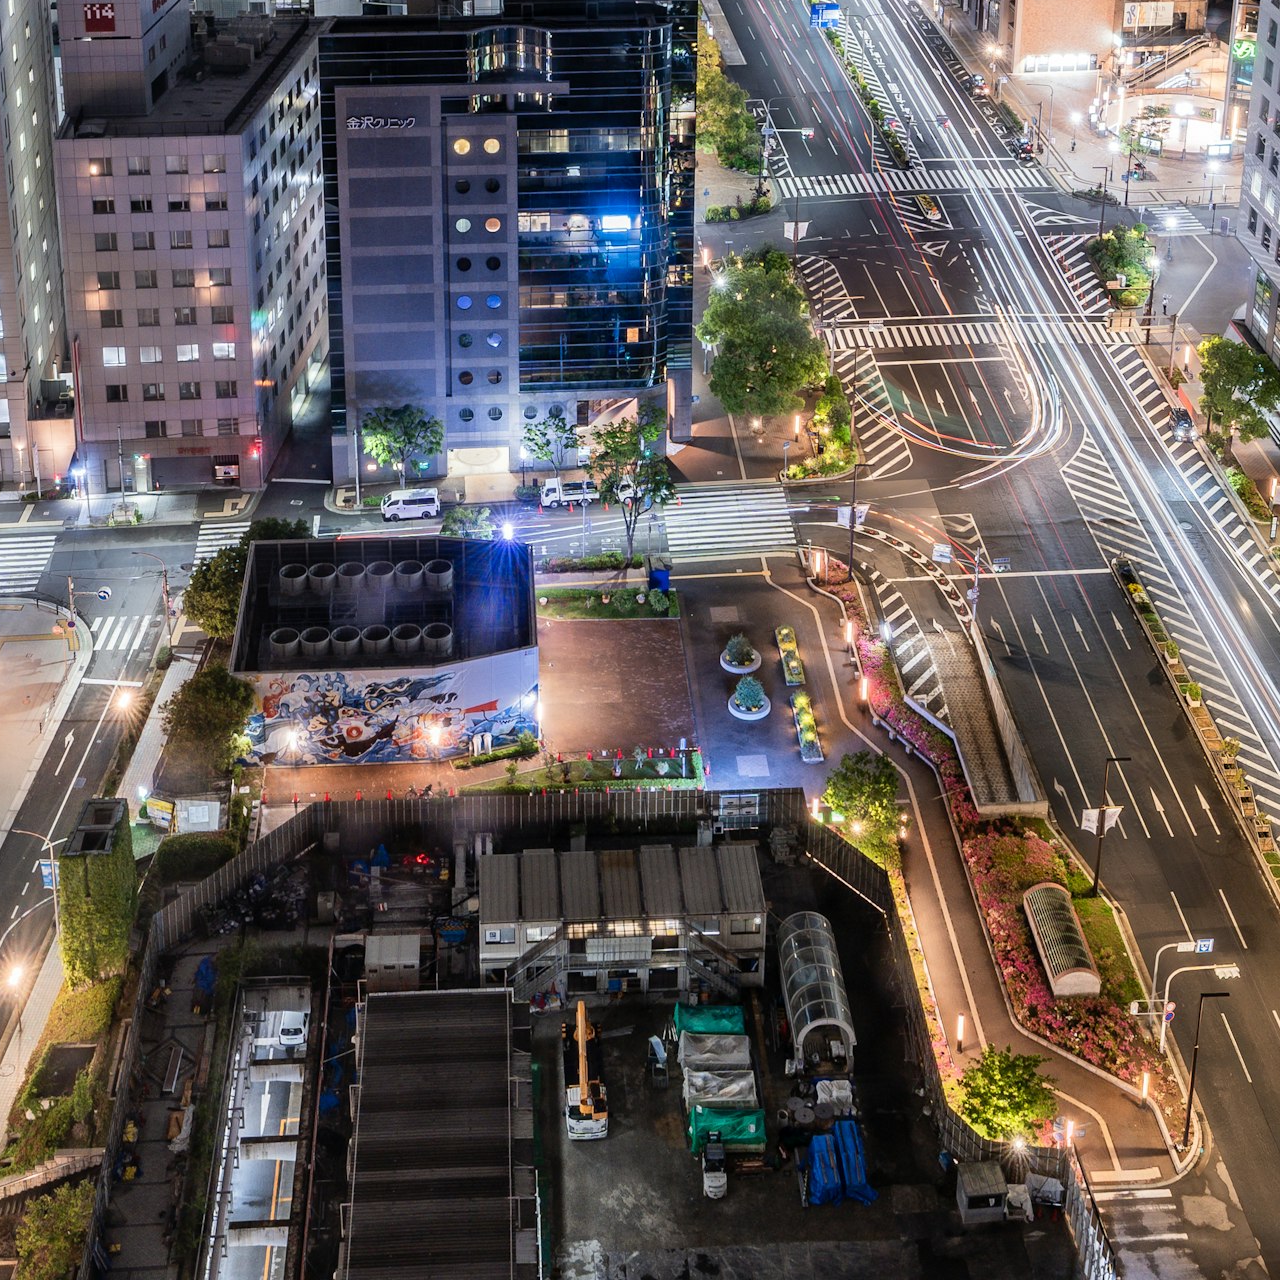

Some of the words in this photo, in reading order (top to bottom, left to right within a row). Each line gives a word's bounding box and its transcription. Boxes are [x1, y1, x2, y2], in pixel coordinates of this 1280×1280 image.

[84, 4, 114, 19] 114
[347, 116, 415, 130] 金沢クリニック
